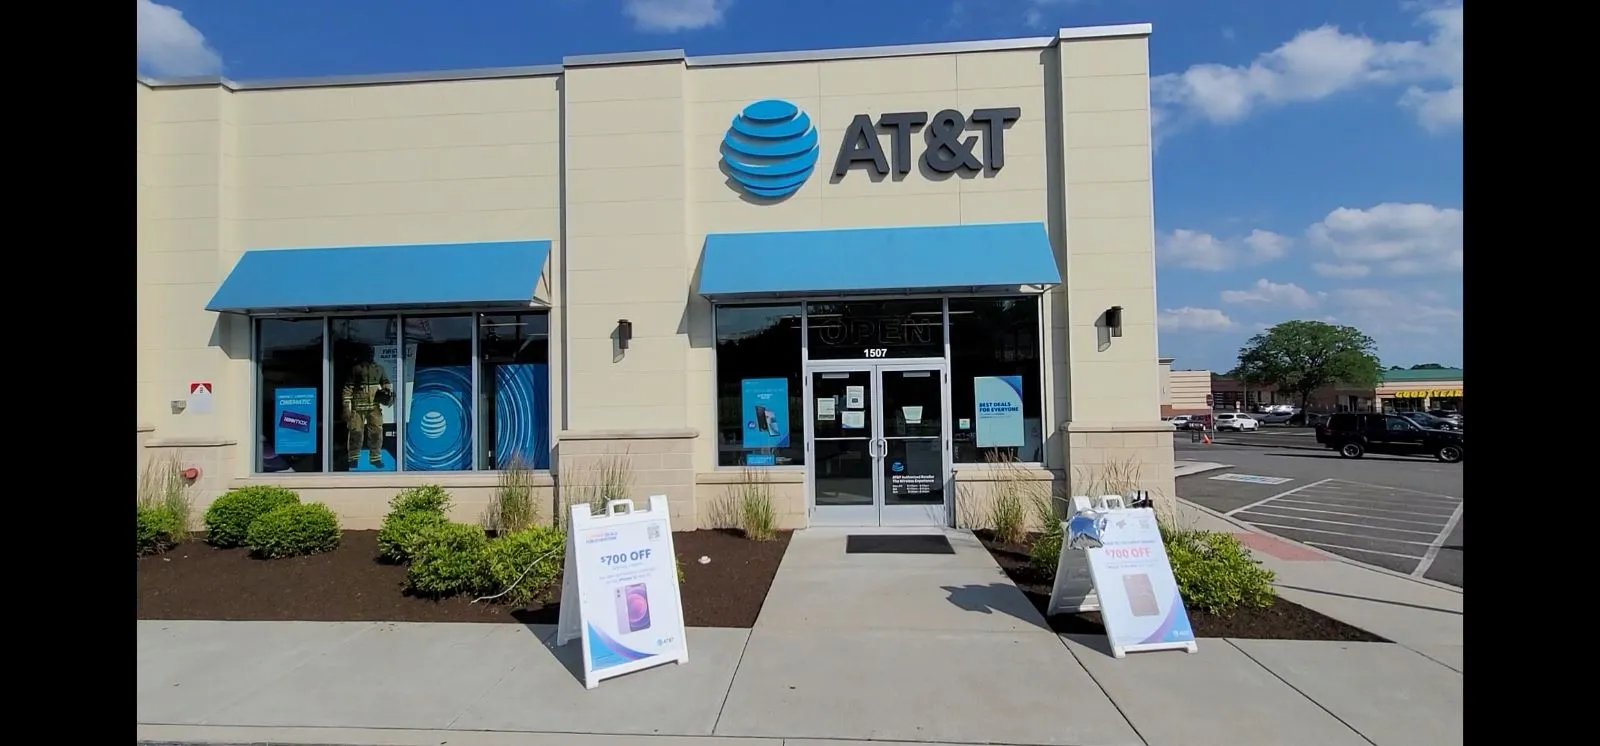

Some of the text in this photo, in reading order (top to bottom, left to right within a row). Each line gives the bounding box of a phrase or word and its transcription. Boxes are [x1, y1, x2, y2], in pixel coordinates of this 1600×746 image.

[834, 107, 1021, 177] AT&T
[820, 319, 932, 345] OPEN
[863, 348, 888, 358] 1507
[600, 548, 652, 566] $700 OFF
[1105, 547, 1152, 559] $700 OFF
